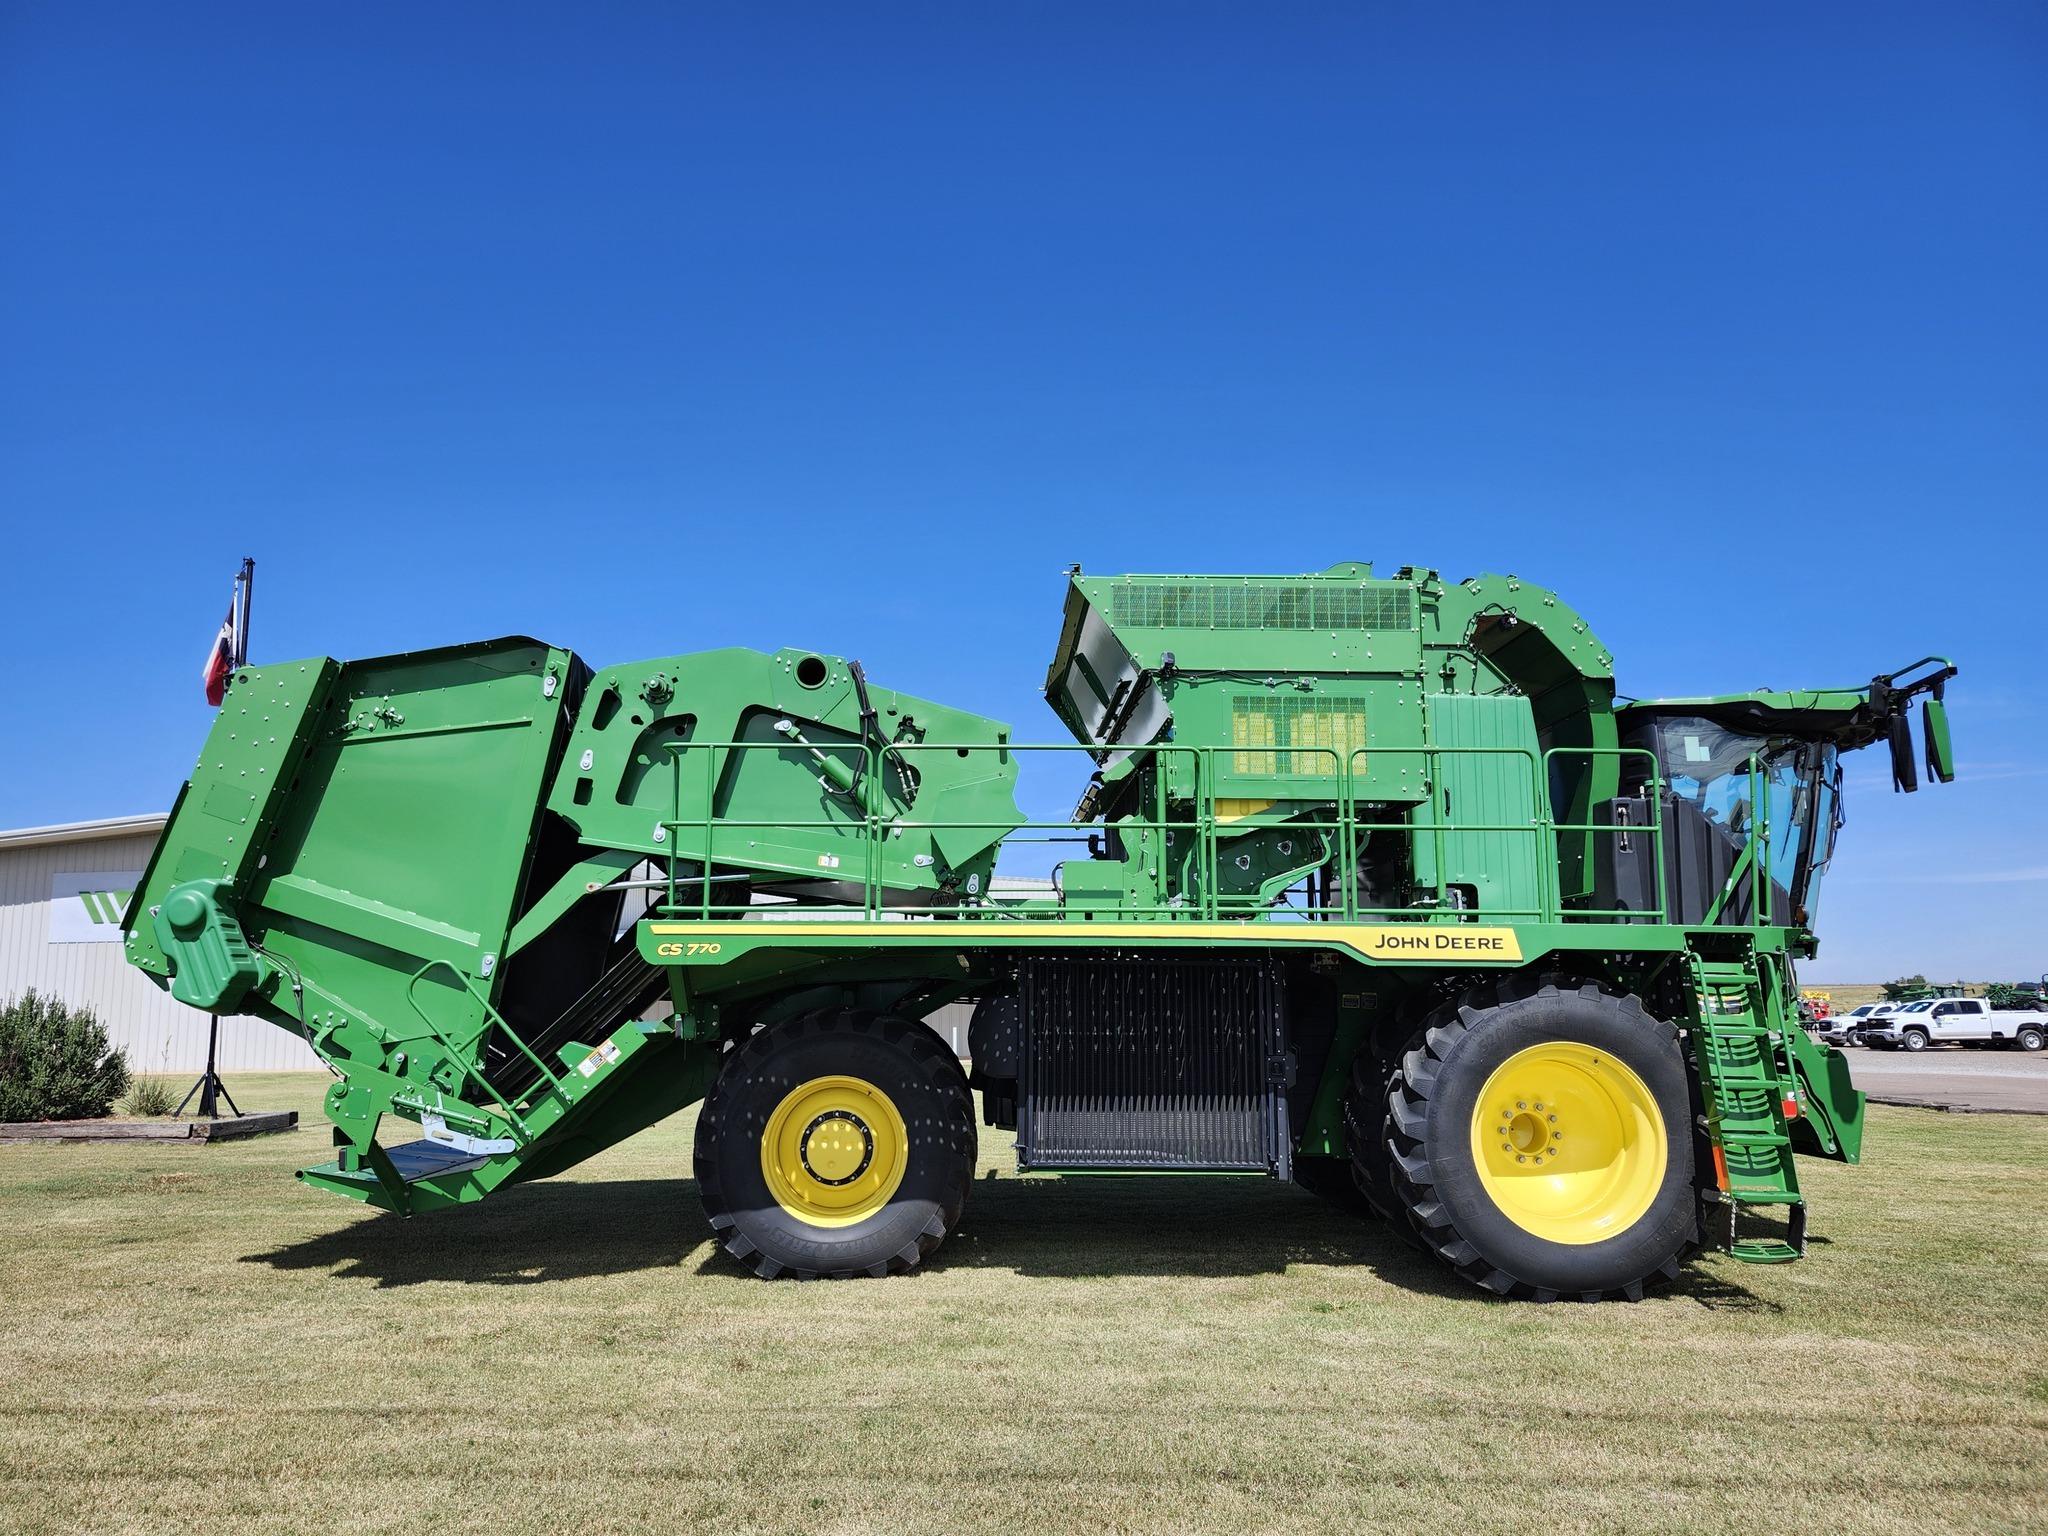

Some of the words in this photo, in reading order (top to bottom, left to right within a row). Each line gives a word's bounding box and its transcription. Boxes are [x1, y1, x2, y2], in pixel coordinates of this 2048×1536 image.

[1375, 934, 1430, 949] JOHN
[1435, 935, 1504, 950] DEERE
[657, 943, 684, 956] CS
[685, 943, 722, 956] 770
